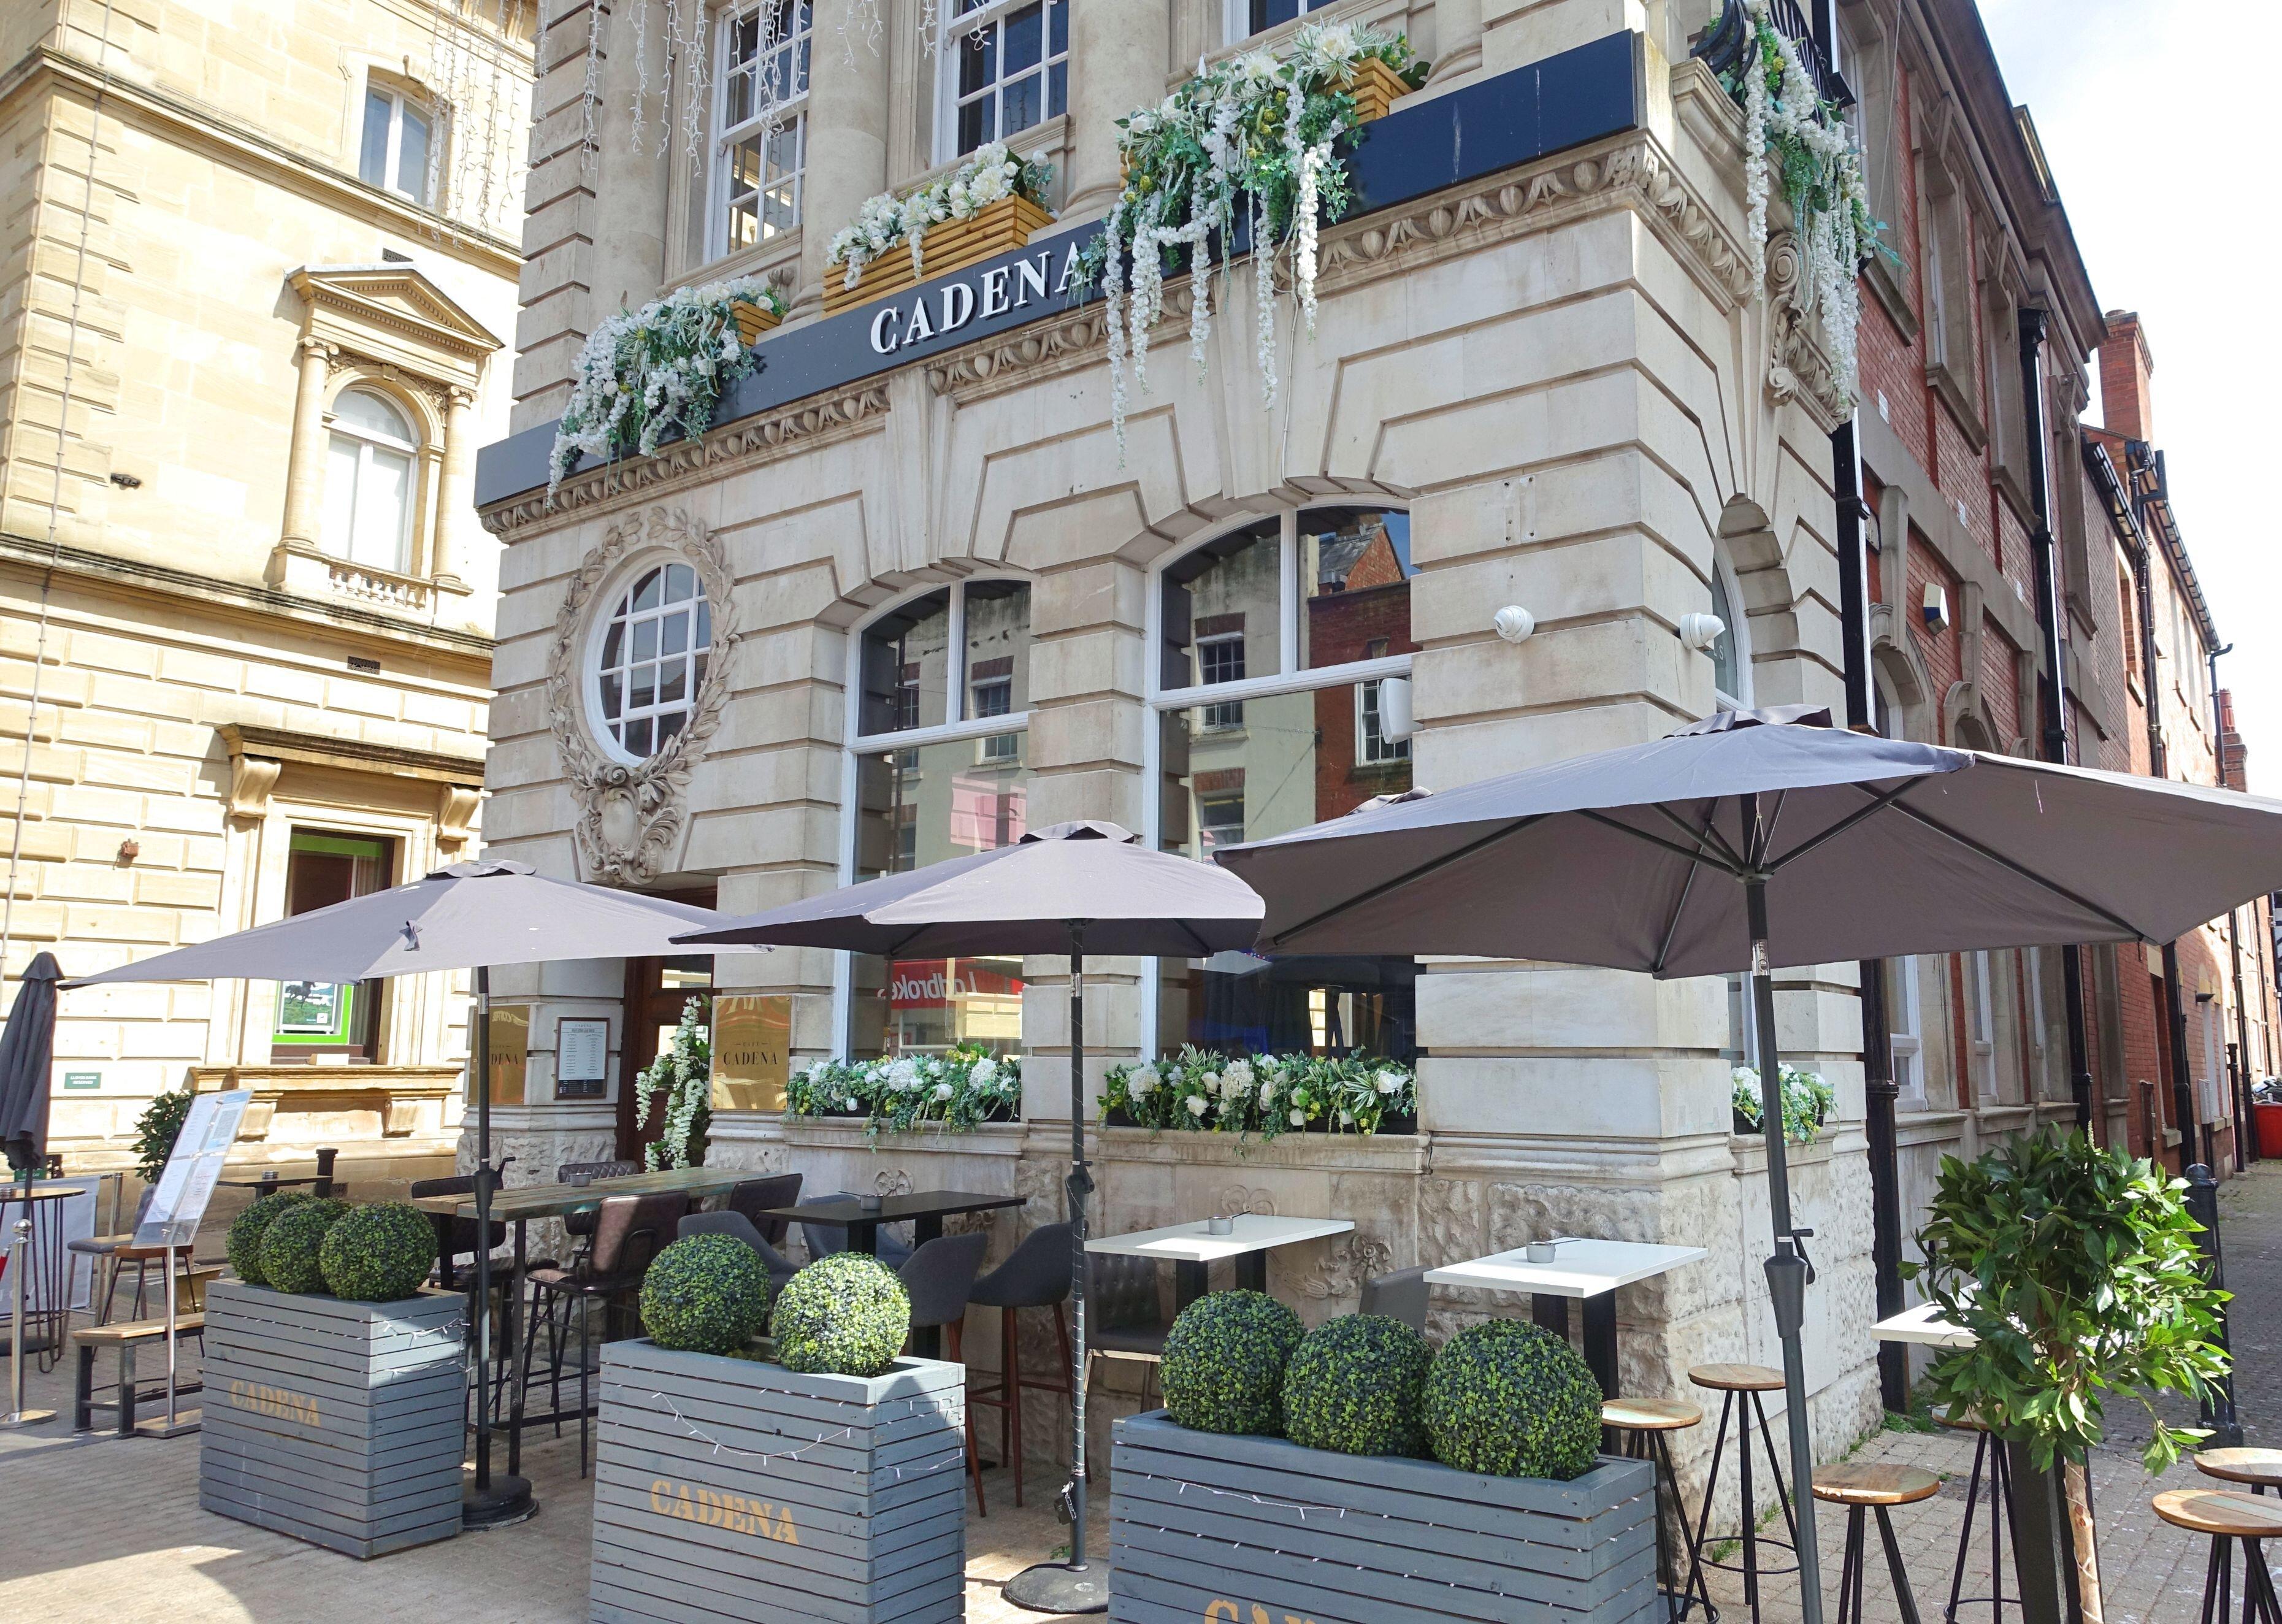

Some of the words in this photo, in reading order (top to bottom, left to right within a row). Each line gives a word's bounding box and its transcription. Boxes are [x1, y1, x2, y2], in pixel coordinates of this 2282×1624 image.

[871, 241, 1092, 354] CADENA
[477, 1053, 519, 1065] DENA
[723, 1051, 778, 1065] CADENA
[229, 1380, 321, 1427] CADENA
[651, 1480, 800, 1545] CADENA
